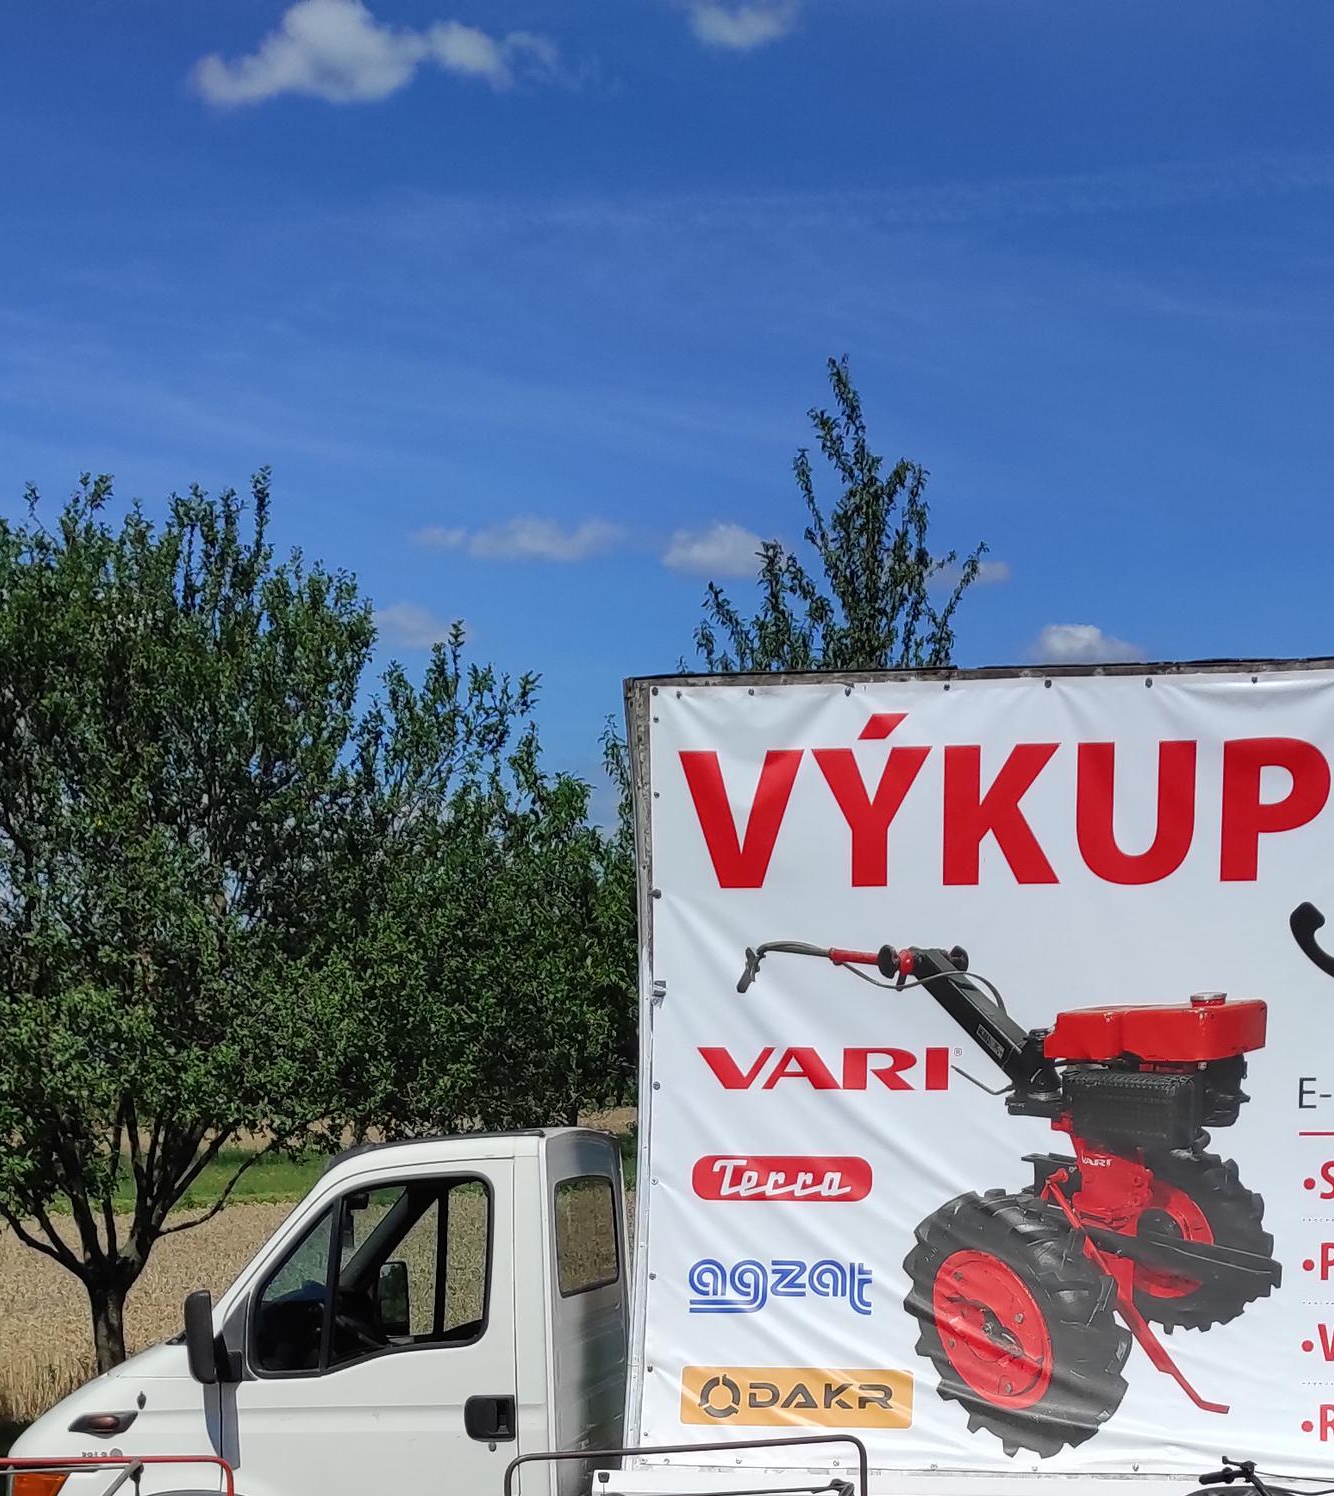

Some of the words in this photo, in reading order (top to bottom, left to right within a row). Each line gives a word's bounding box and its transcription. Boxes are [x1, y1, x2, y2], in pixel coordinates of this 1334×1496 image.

[678, 712, 1332, 890] VÝKUP
[712, 1159, 852, 1197] Terra
[686, 1257, 874, 1317] agzat
[748, 1382, 893, 1410] DAKR
